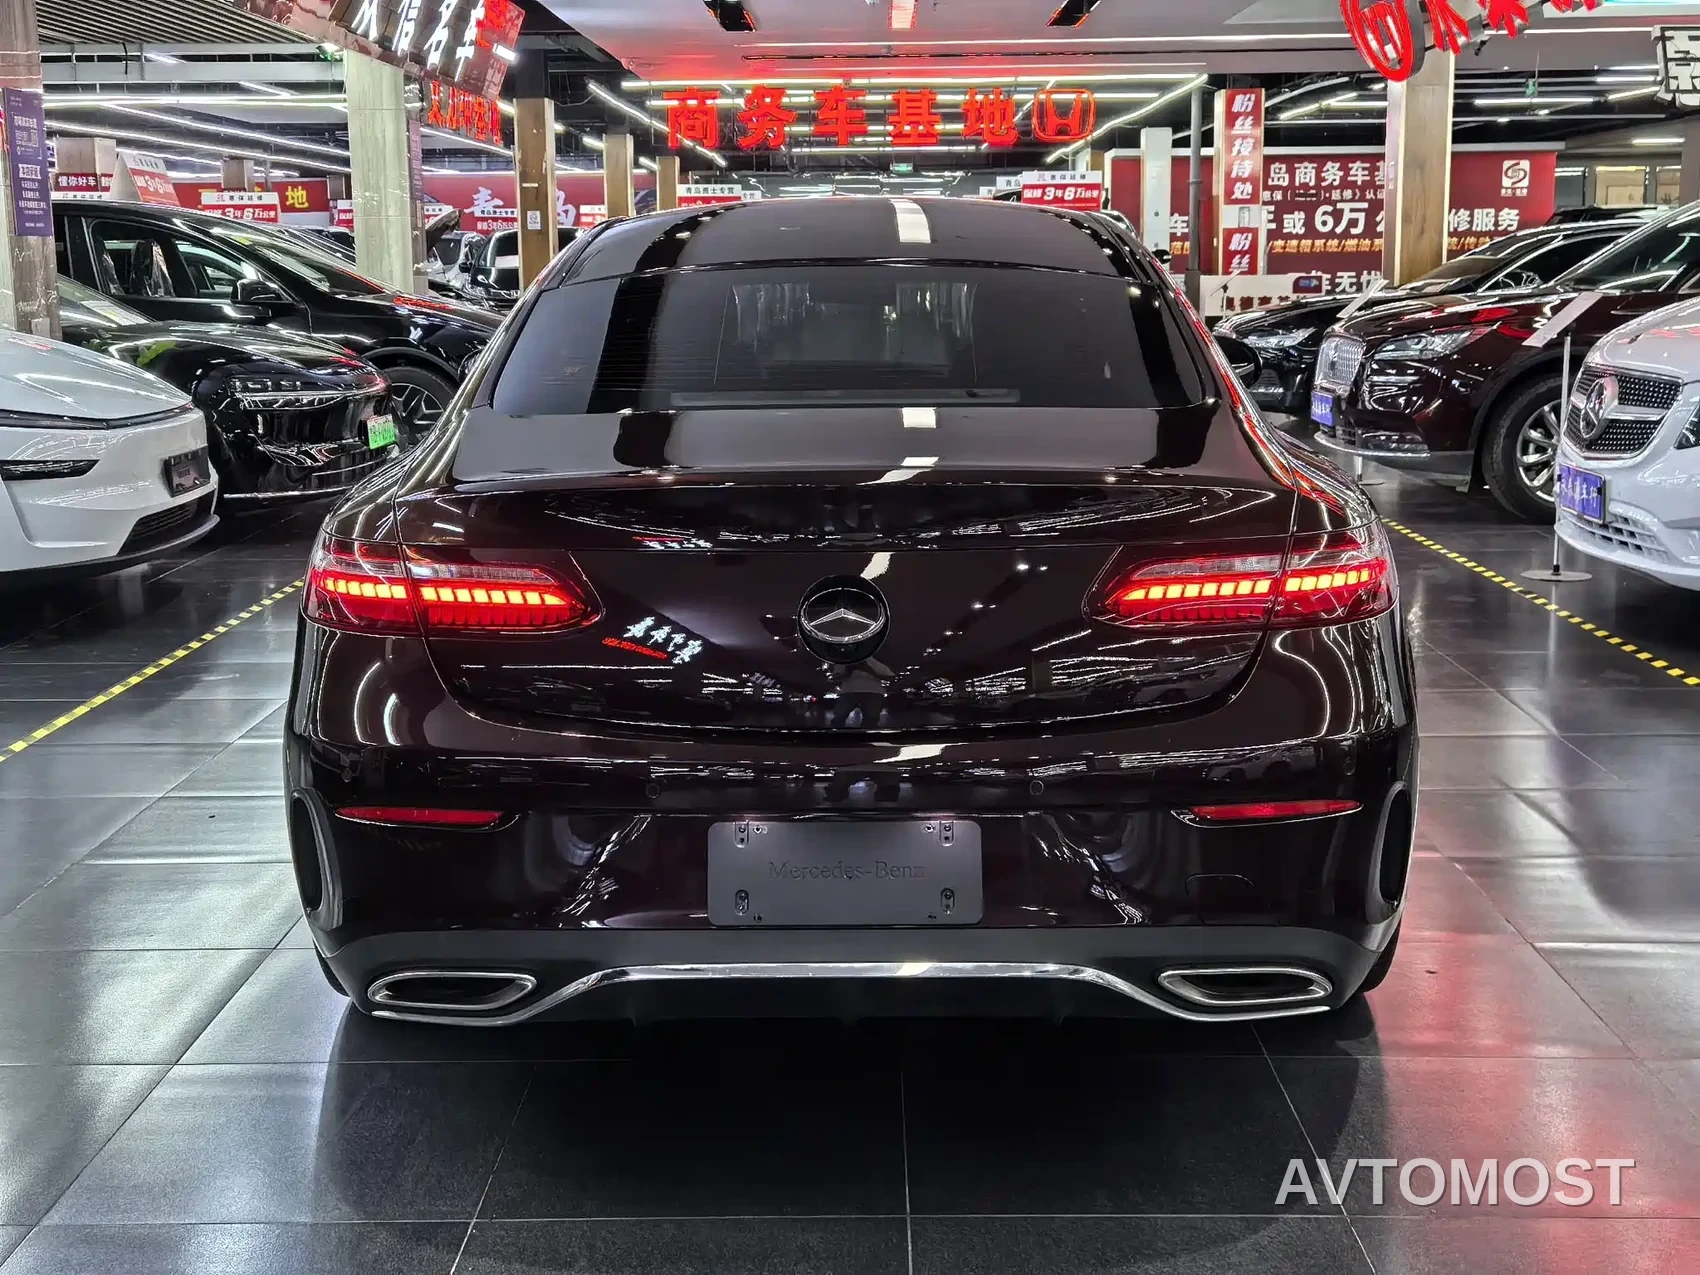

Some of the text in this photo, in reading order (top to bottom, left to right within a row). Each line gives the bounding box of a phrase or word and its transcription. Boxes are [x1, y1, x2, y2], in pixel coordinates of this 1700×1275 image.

[663, 84, 1018, 149] 商务车基地
[1230, 93, 1256, 200] 粉丝接待处
[286, 186, 309, 209] 地
[1023, 186, 1099, 201] 保修3年6万公里
[1448, 207, 1520, 232] 修服务
[1229, 233, 1253, 273] 粉丝
[769, 860, 926, 881] Mercedes-Benz
